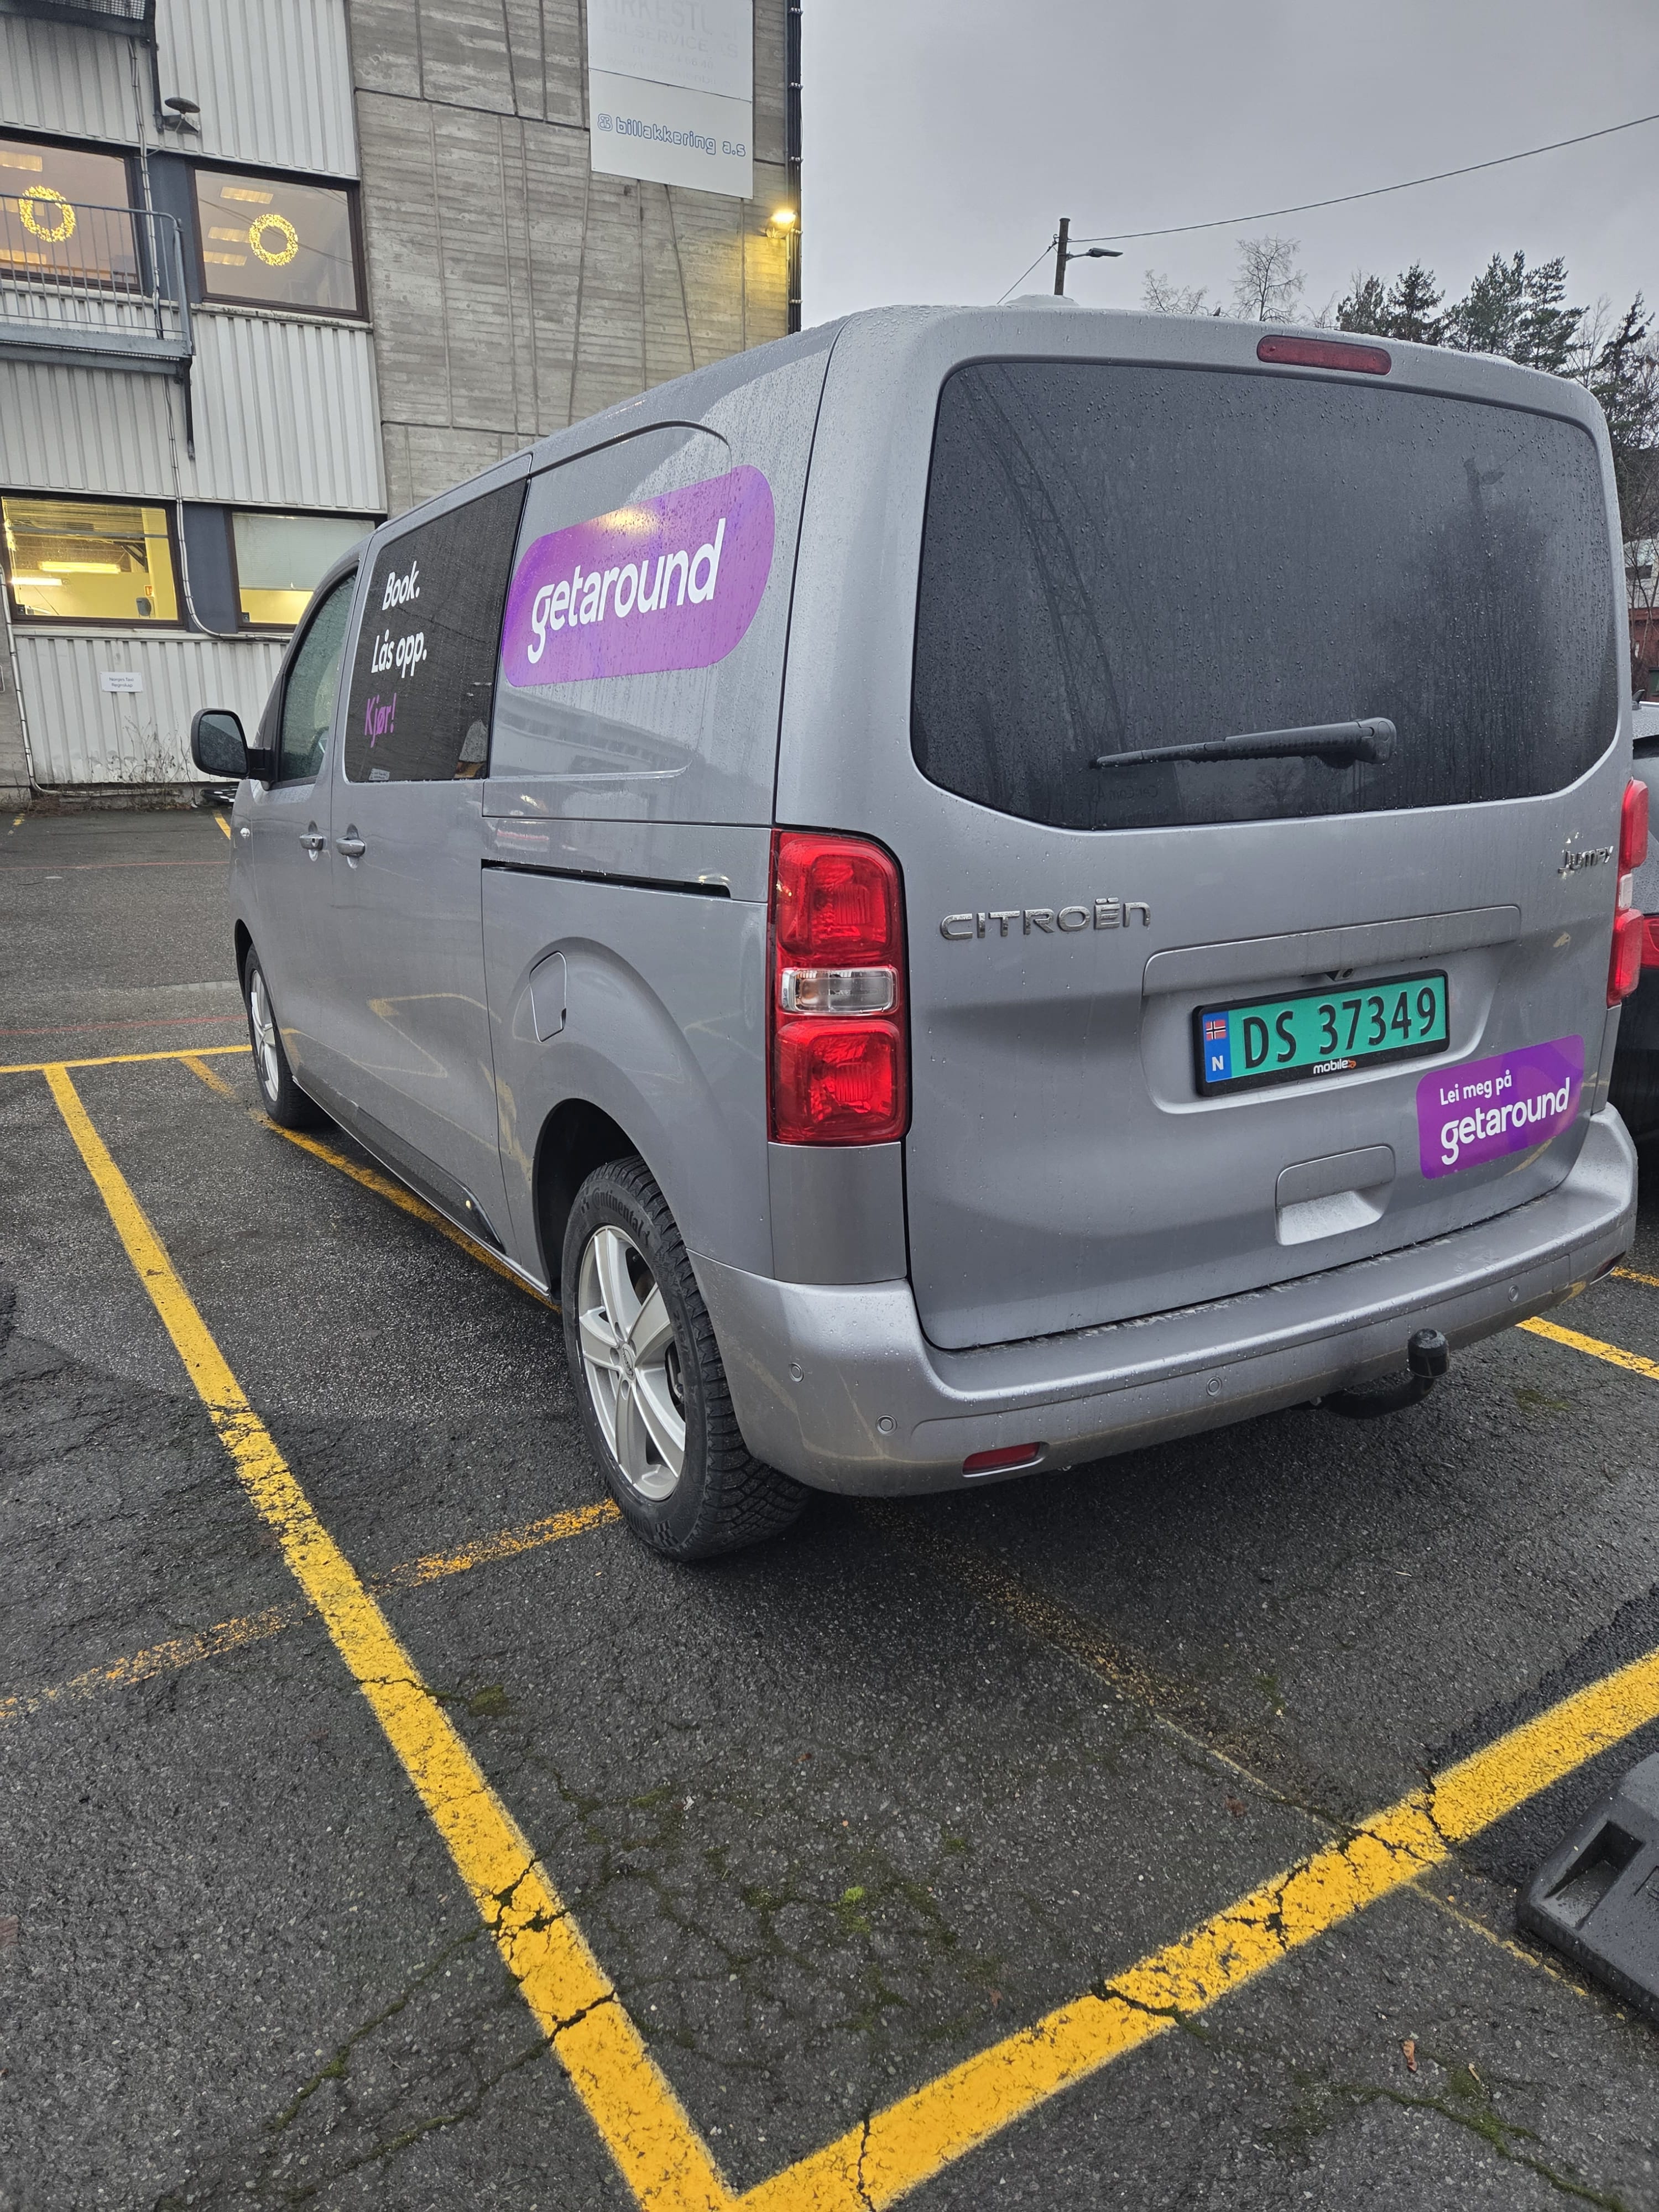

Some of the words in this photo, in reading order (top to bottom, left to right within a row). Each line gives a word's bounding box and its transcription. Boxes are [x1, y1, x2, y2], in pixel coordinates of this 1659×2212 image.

[615, 117, 716, 155] billakkering
[722, 140, 746, 157] a.s
[382, 561, 420, 610] Book.
[528, 518, 726, 664] getaround
[371, 629, 394, 674] Lås
[396, 632, 427, 679] opp.
[364, 693, 397, 748] Kjør!
[1243, 1011, 1297, 1069] DS
[1317, 987, 1437, 1055] 37349
[1212, 1055, 1224, 1072] N
[1440, 1083, 1459, 1105] Lei
[1463, 1080, 1492, 1098] meg
[1495, 1070, 1512, 1095] på
[1441, 1077, 1570, 1166] getaround
[592, 1187, 644, 1239] Continental
